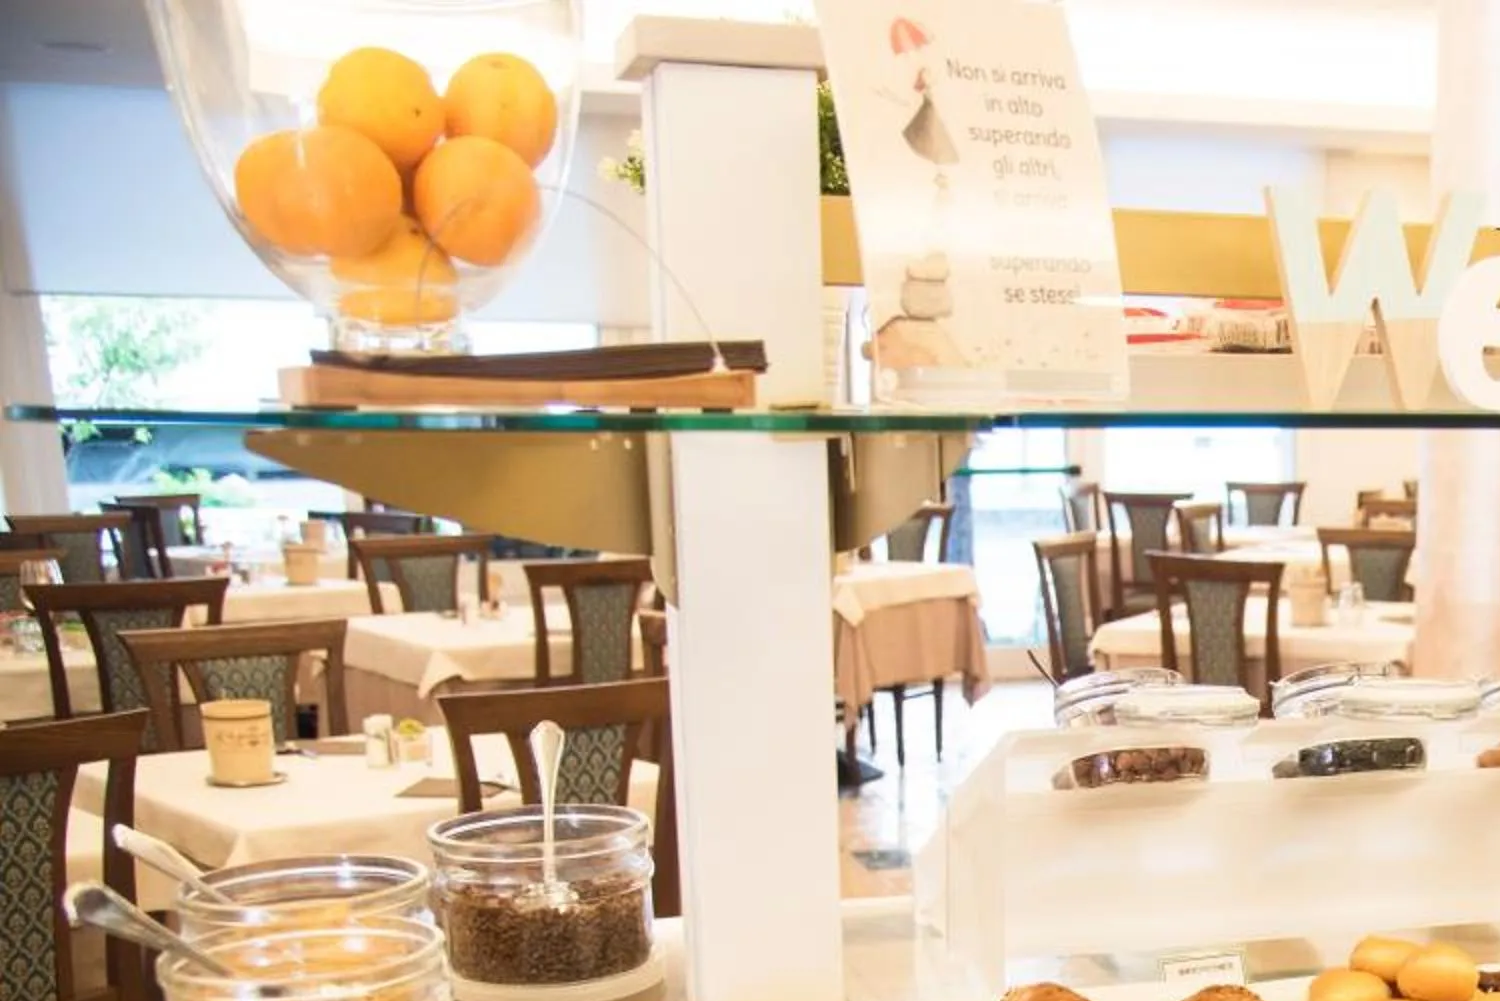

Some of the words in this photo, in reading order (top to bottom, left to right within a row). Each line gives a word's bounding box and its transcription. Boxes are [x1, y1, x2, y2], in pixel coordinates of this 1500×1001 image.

[944, 58, 988, 84] Non
[990, 68, 1008, 84] si
[1010, 68, 1068, 91] arriva
[984, 94, 1003, 113] in
[1007, 96, 1045, 118] alto
[966, 126, 1073, 150] superando
[992, 157, 1014, 180] gli
[988, 255, 1093, 278] superando
[1003, 286, 1026, 305] se
